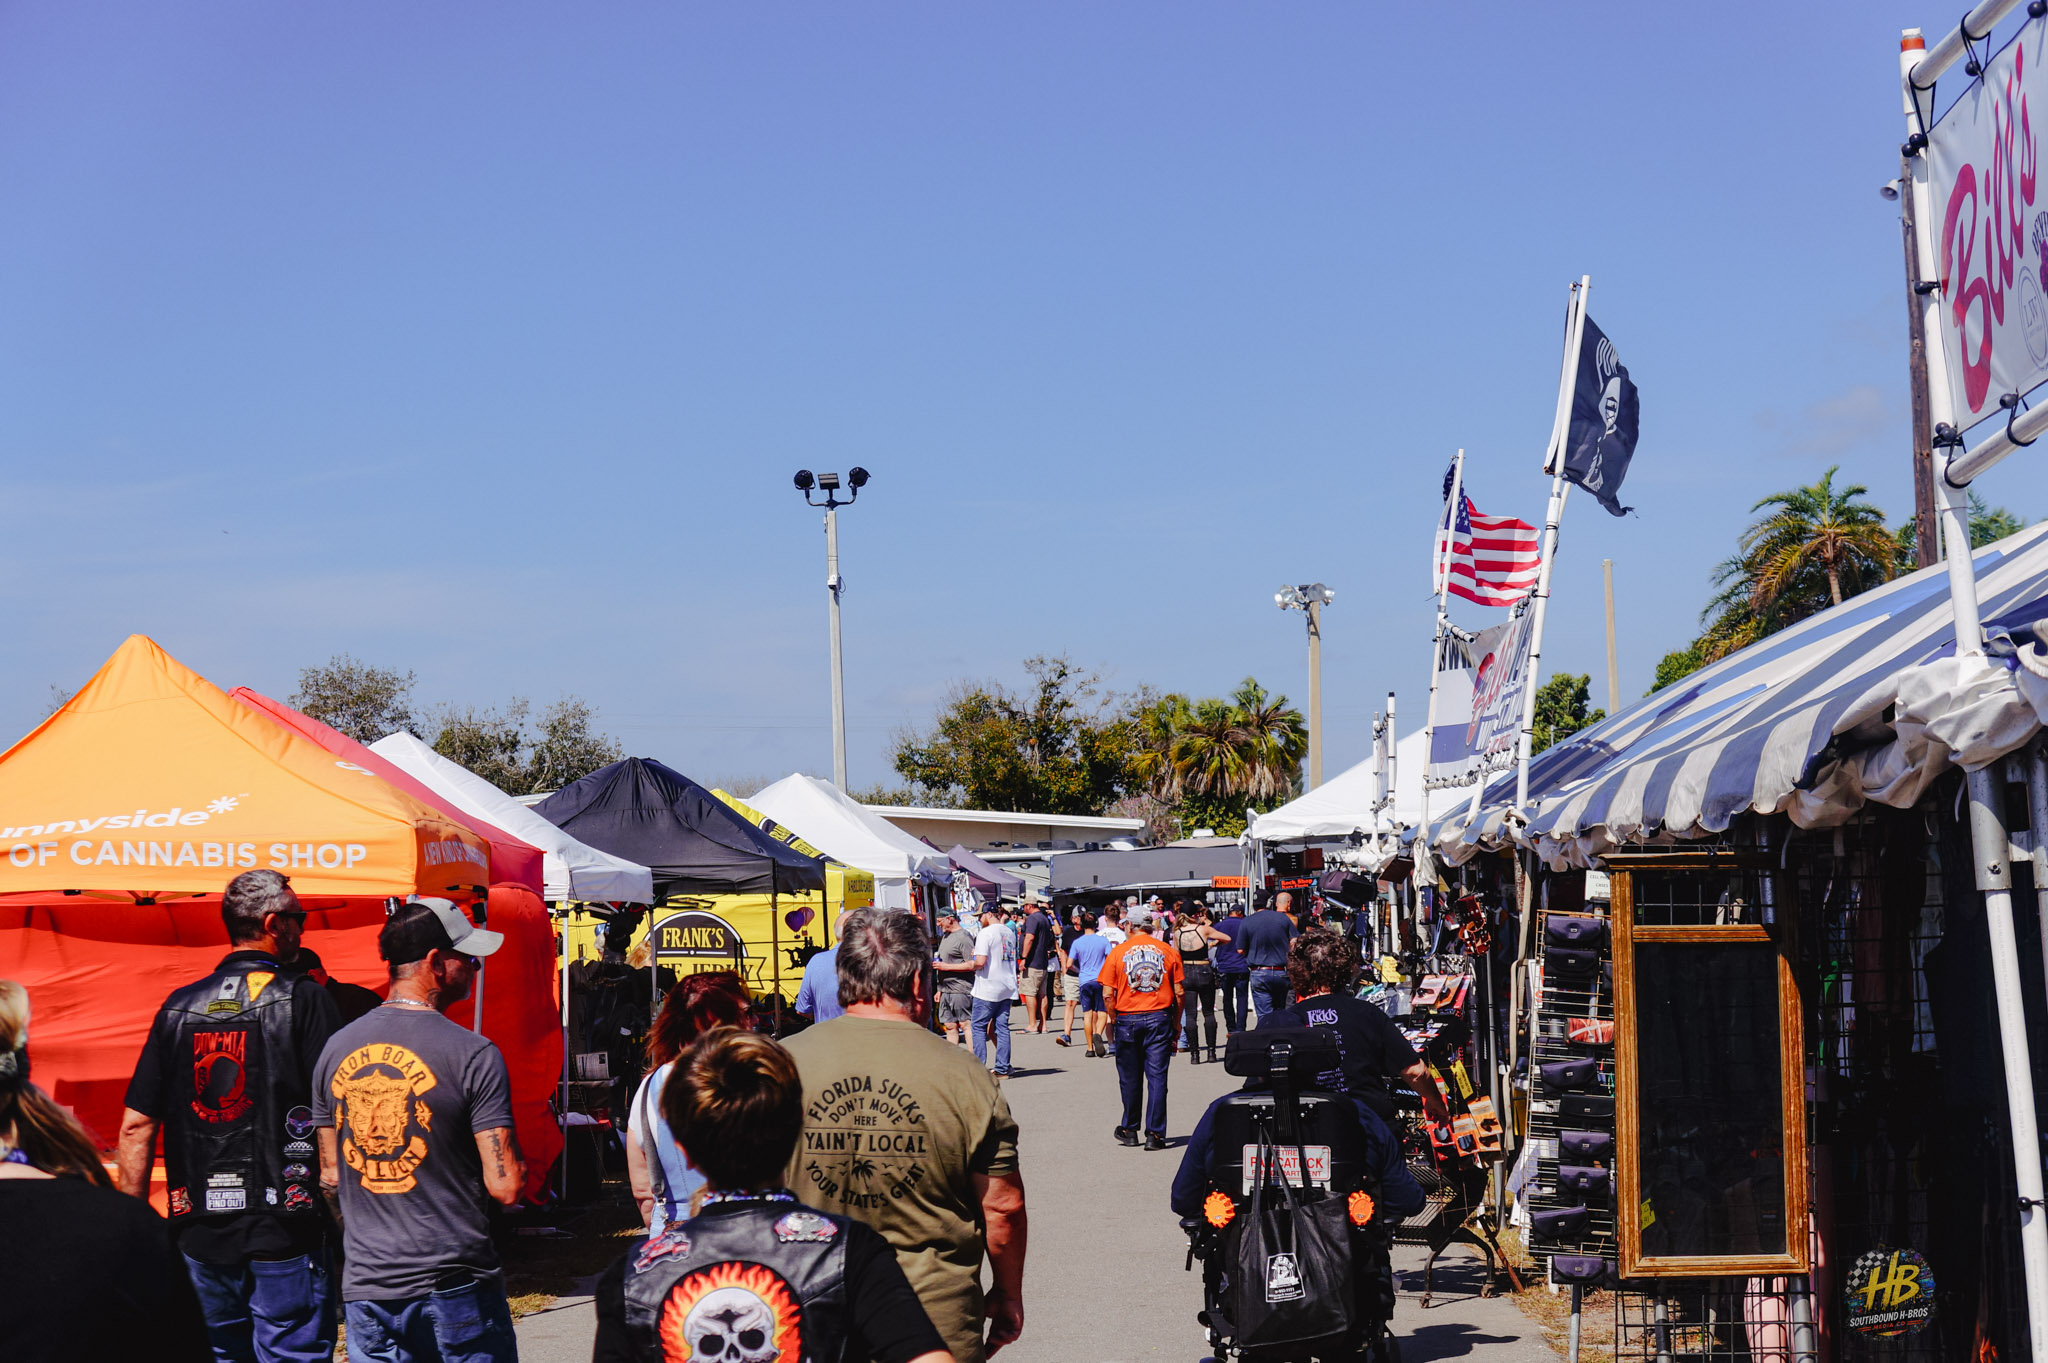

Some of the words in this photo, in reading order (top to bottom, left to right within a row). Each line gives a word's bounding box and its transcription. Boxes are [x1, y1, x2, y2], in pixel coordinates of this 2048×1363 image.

[9, 841, 58, 868] OF
[70, 840, 257, 868] CANNABIS
[269, 843, 367, 869] SHOP
[662, 927, 725, 949] FRANK'S
[334, 1048, 371, 1086] IRON
[382, 1046, 427, 1086] BOAR
[808, 1075, 873, 1122] FLORIDA
[878, 1079, 925, 1125] SUCKS
[828, 1098, 865, 1123] DON'T
[869, 1098, 903, 1125] MOVE
[854, 1115, 877, 1126] HERE
[805, 1132, 862, 1151] YAIN'T
[868, 1134, 927, 1153] LOCAL
[348, 1149, 421, 1178] SLOON
[1250, 1157, 1324, 1169] PCATCK
[806, 1160, 839, 1198] YOUR
[227, 1199, 243, 1207] OUT
